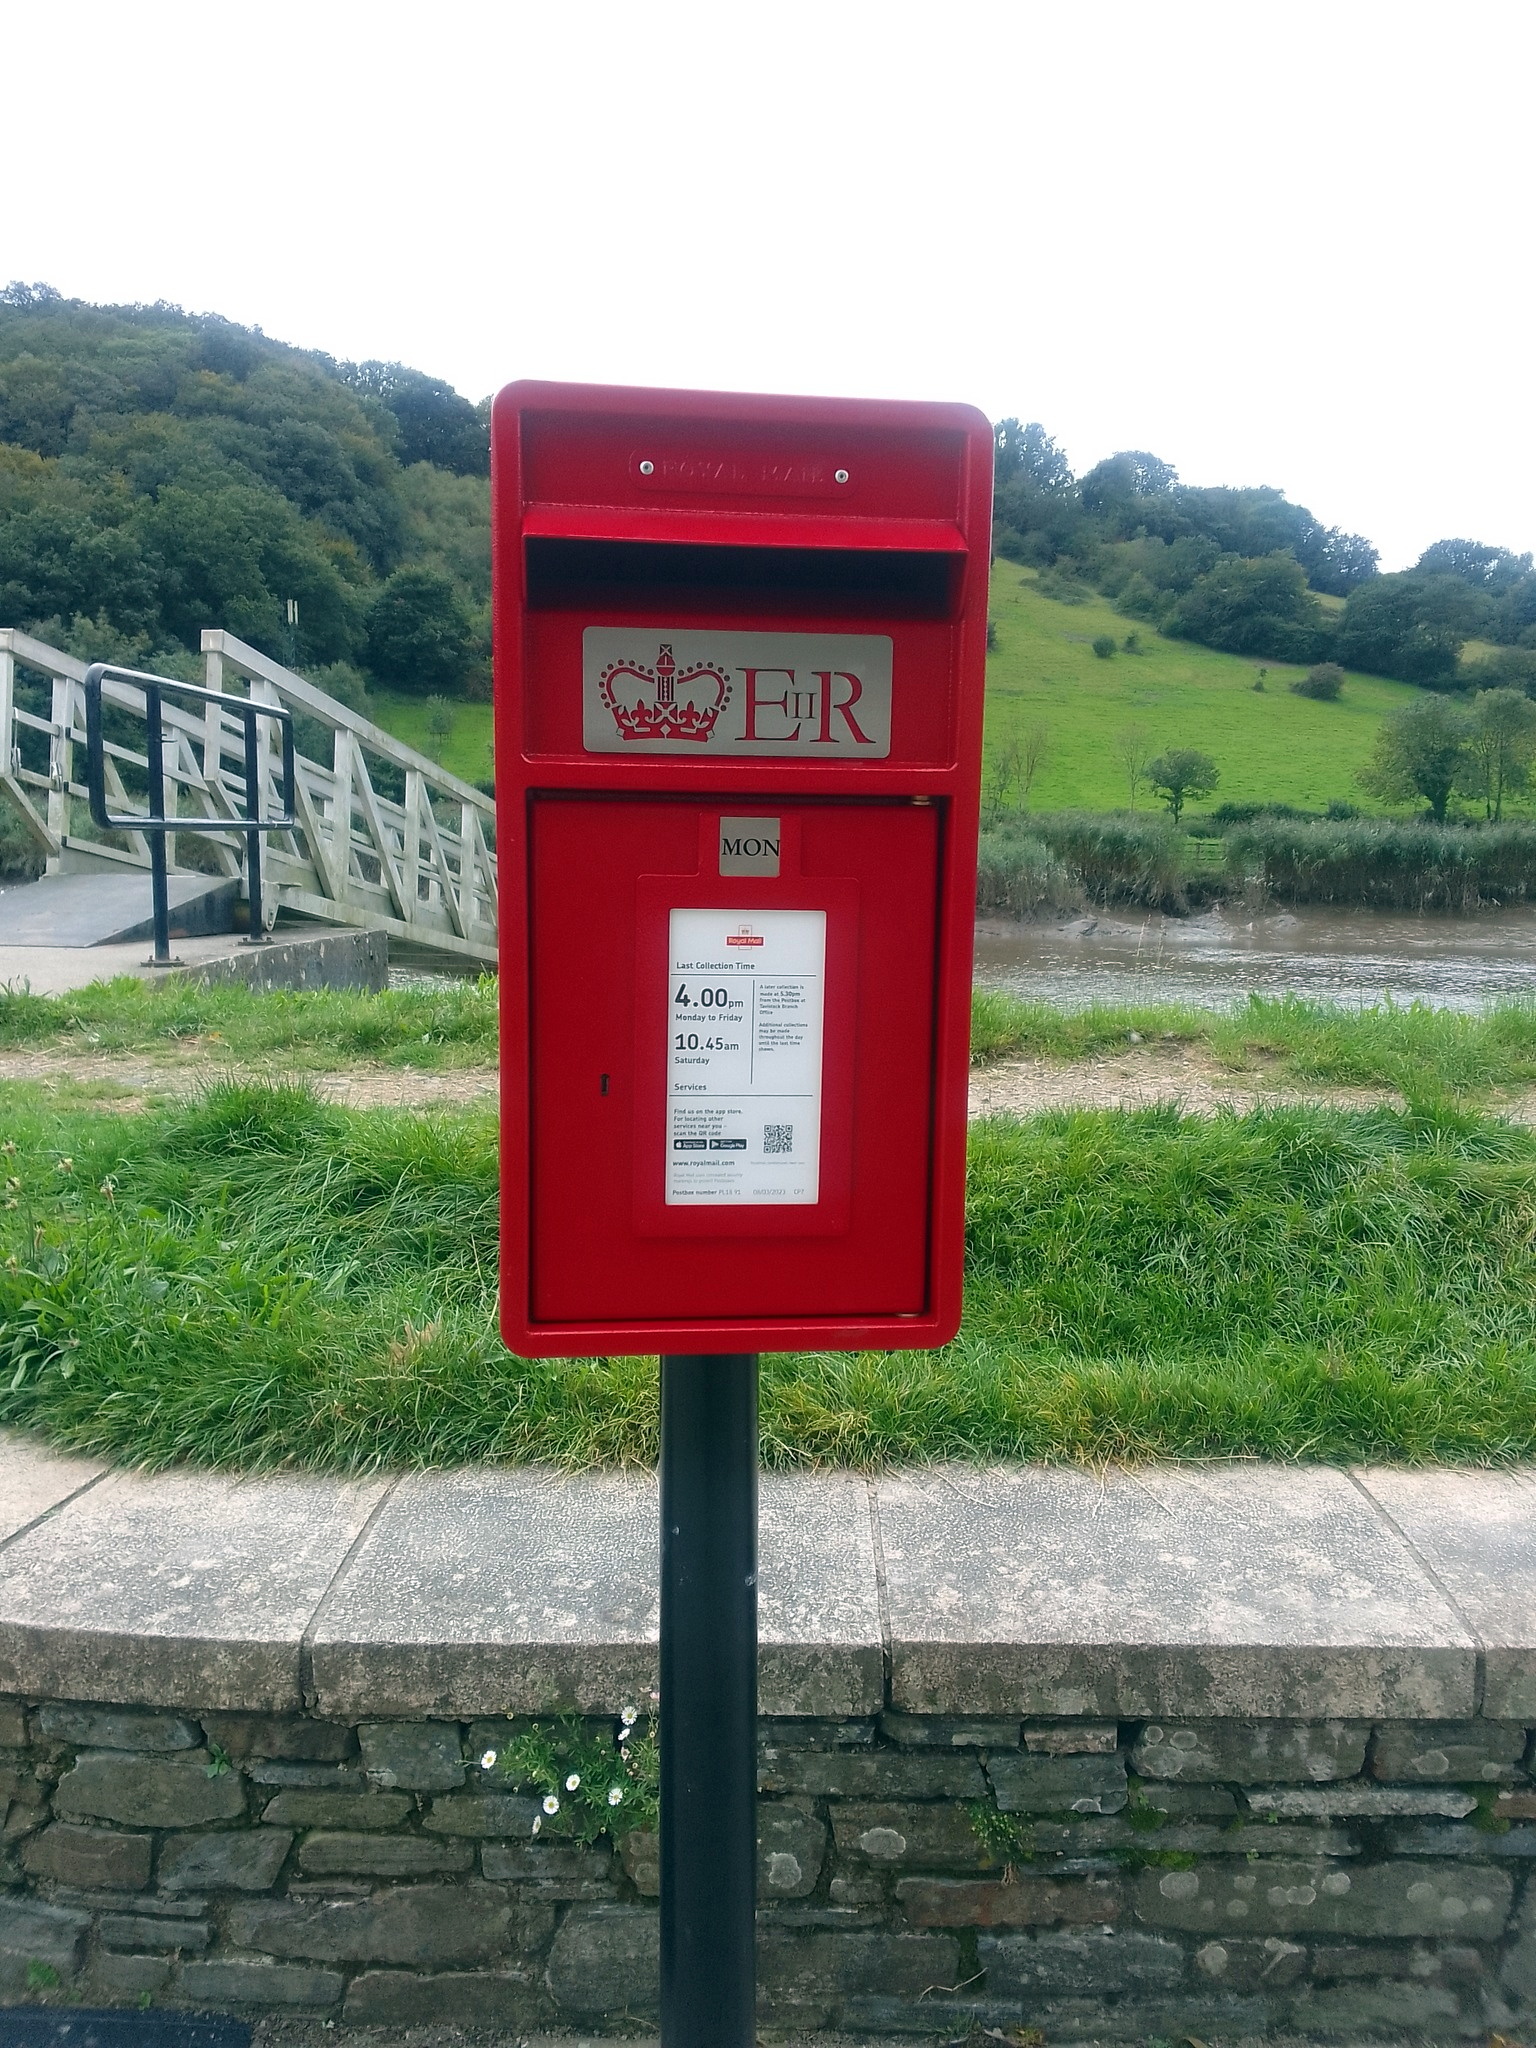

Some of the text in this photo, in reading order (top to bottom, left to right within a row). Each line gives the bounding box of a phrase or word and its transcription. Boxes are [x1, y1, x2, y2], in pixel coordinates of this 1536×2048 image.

[722, 838, 780, 856] MON
[735, 962, 755, 970] Time
[675, 983, 743, 1009] 4.00pm
[675, 1014, 706, 1022] Monday
[719, 1014, 743, 1022] Friday
[675, 1033, 739, 1050] 10.45am
[674, 1056, 710, 1065] Saturday
[674, 1083, 707, 1091] Services
